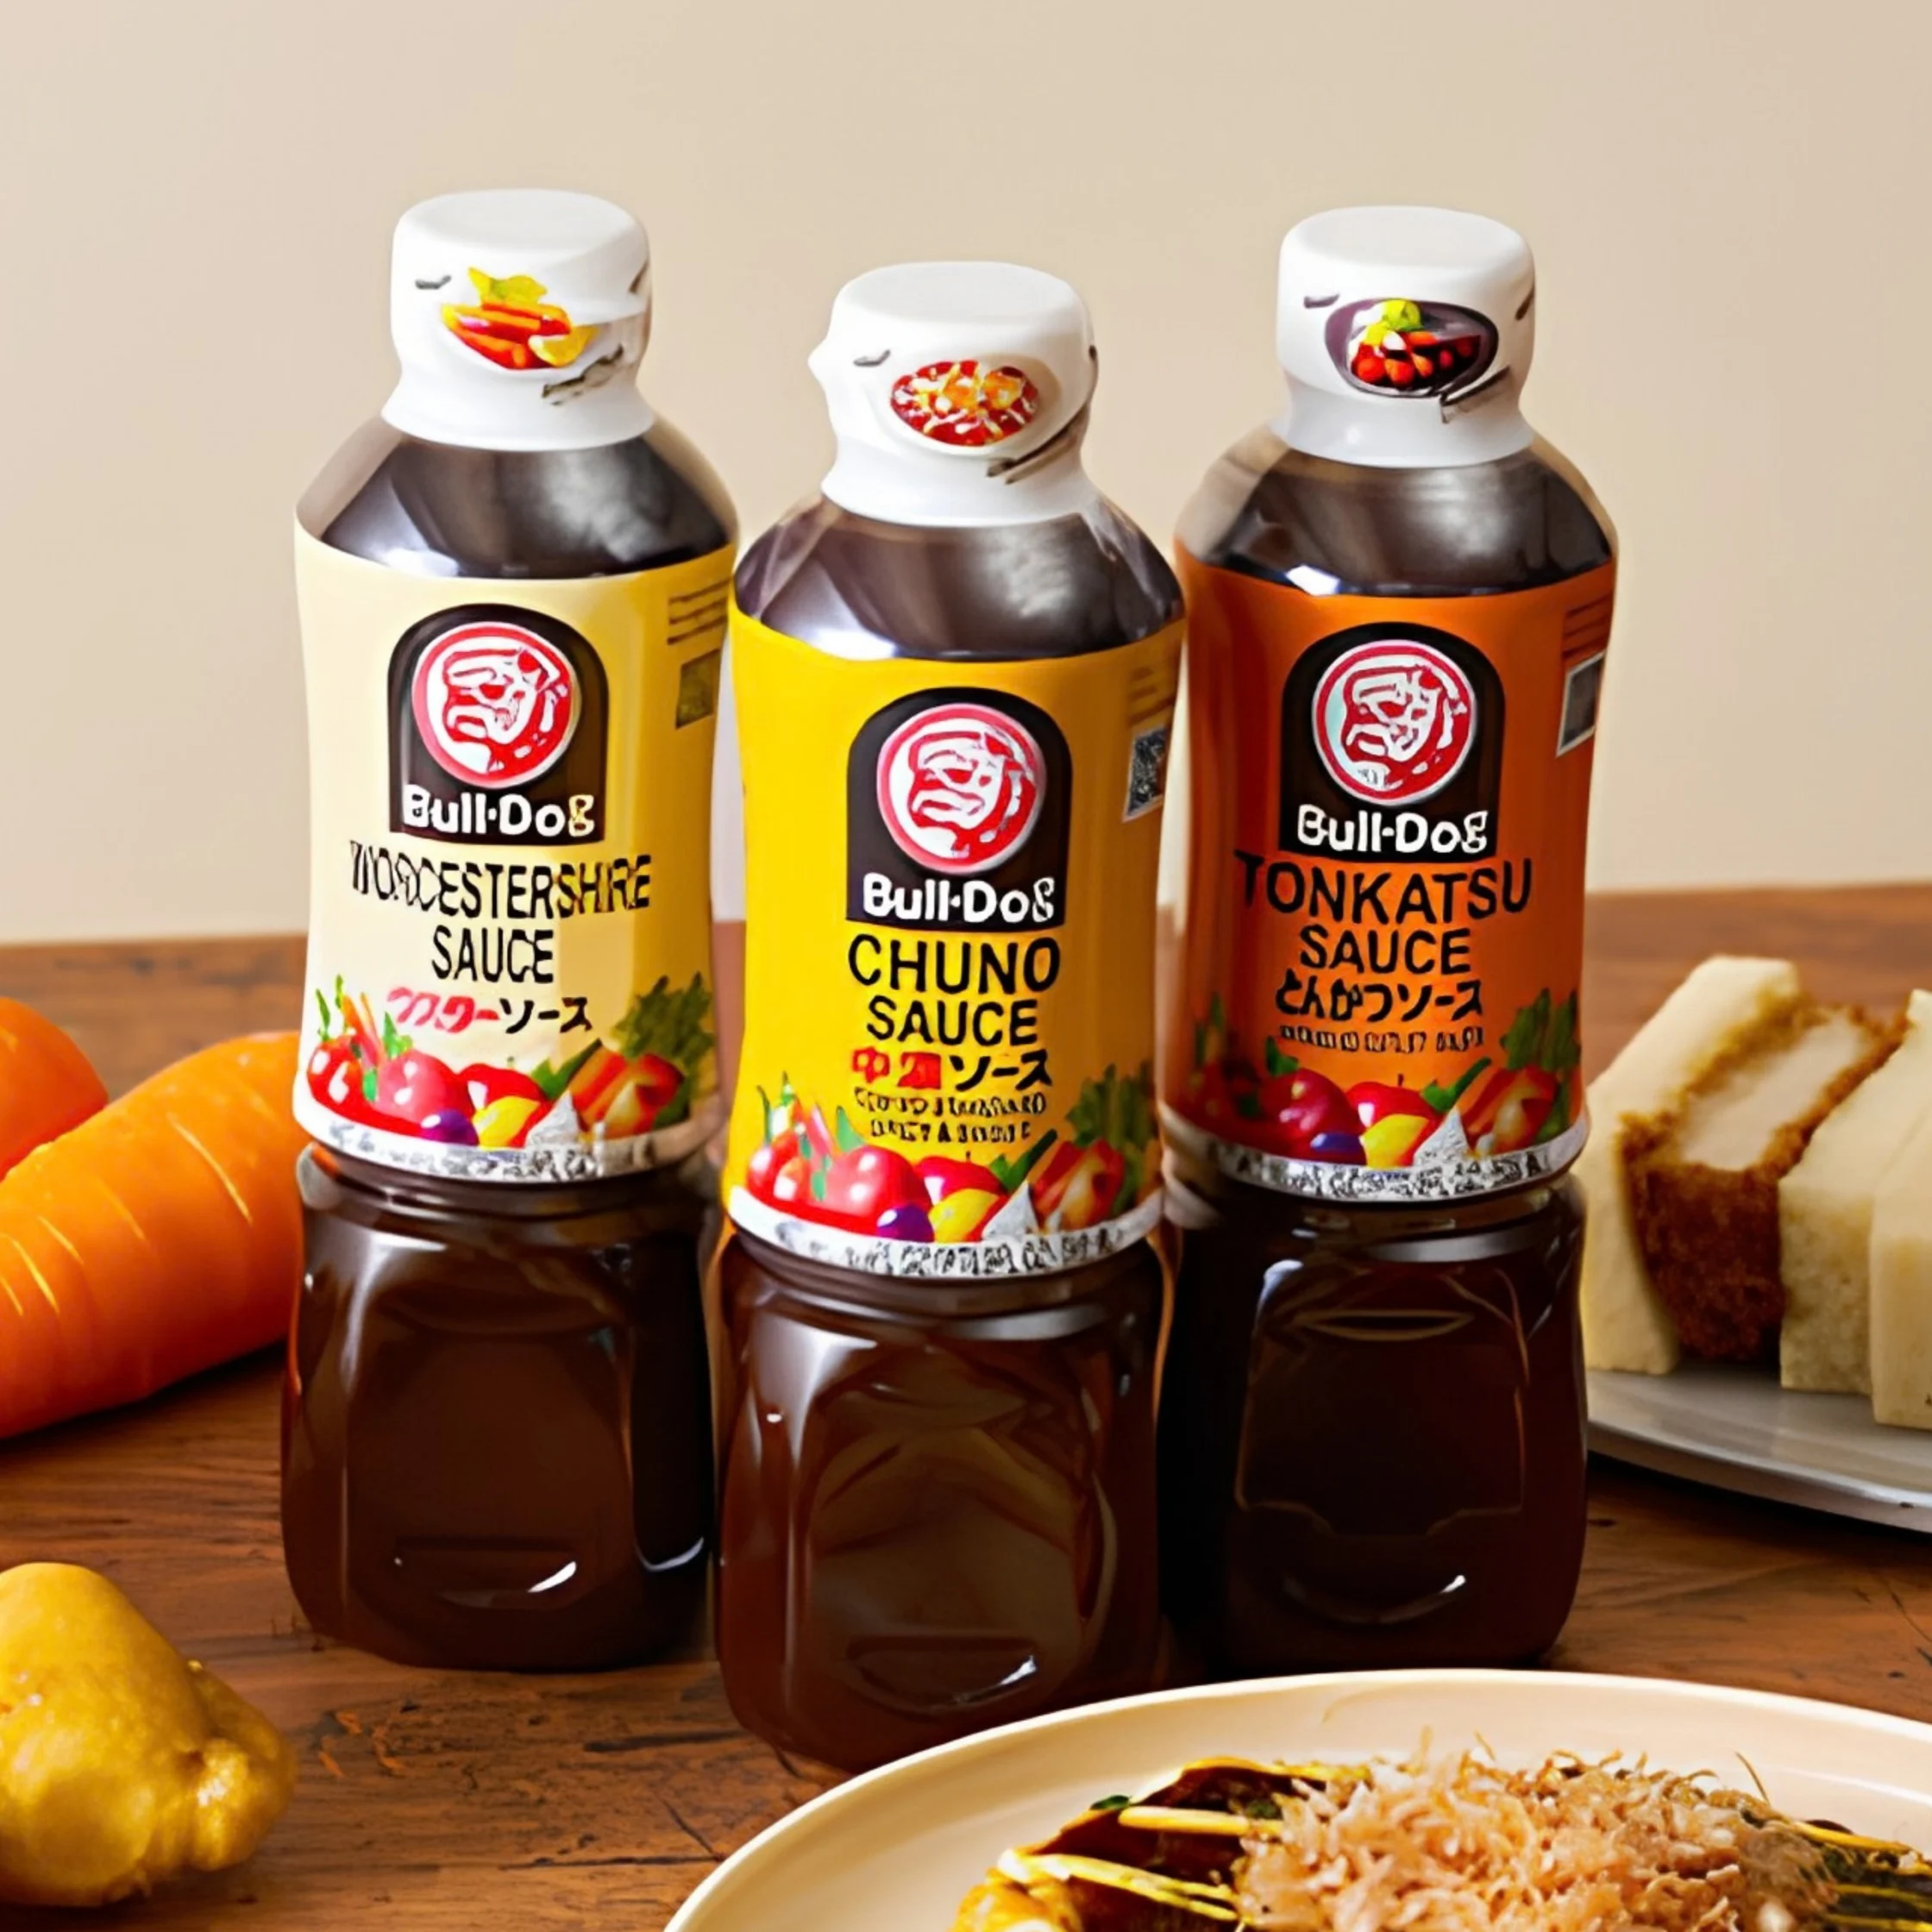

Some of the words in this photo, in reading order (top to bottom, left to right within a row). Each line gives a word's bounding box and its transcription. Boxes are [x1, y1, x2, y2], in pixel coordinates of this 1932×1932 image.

[1235, 851, 1532, 925] TONKATSU
[431, 925, 554, 983] SAUCE
[848, 934, 1060, 994] CHUNO
[1299, 925, 1471, 974] SAUCE
[867, 995, 1038, 1046] SAUCE
